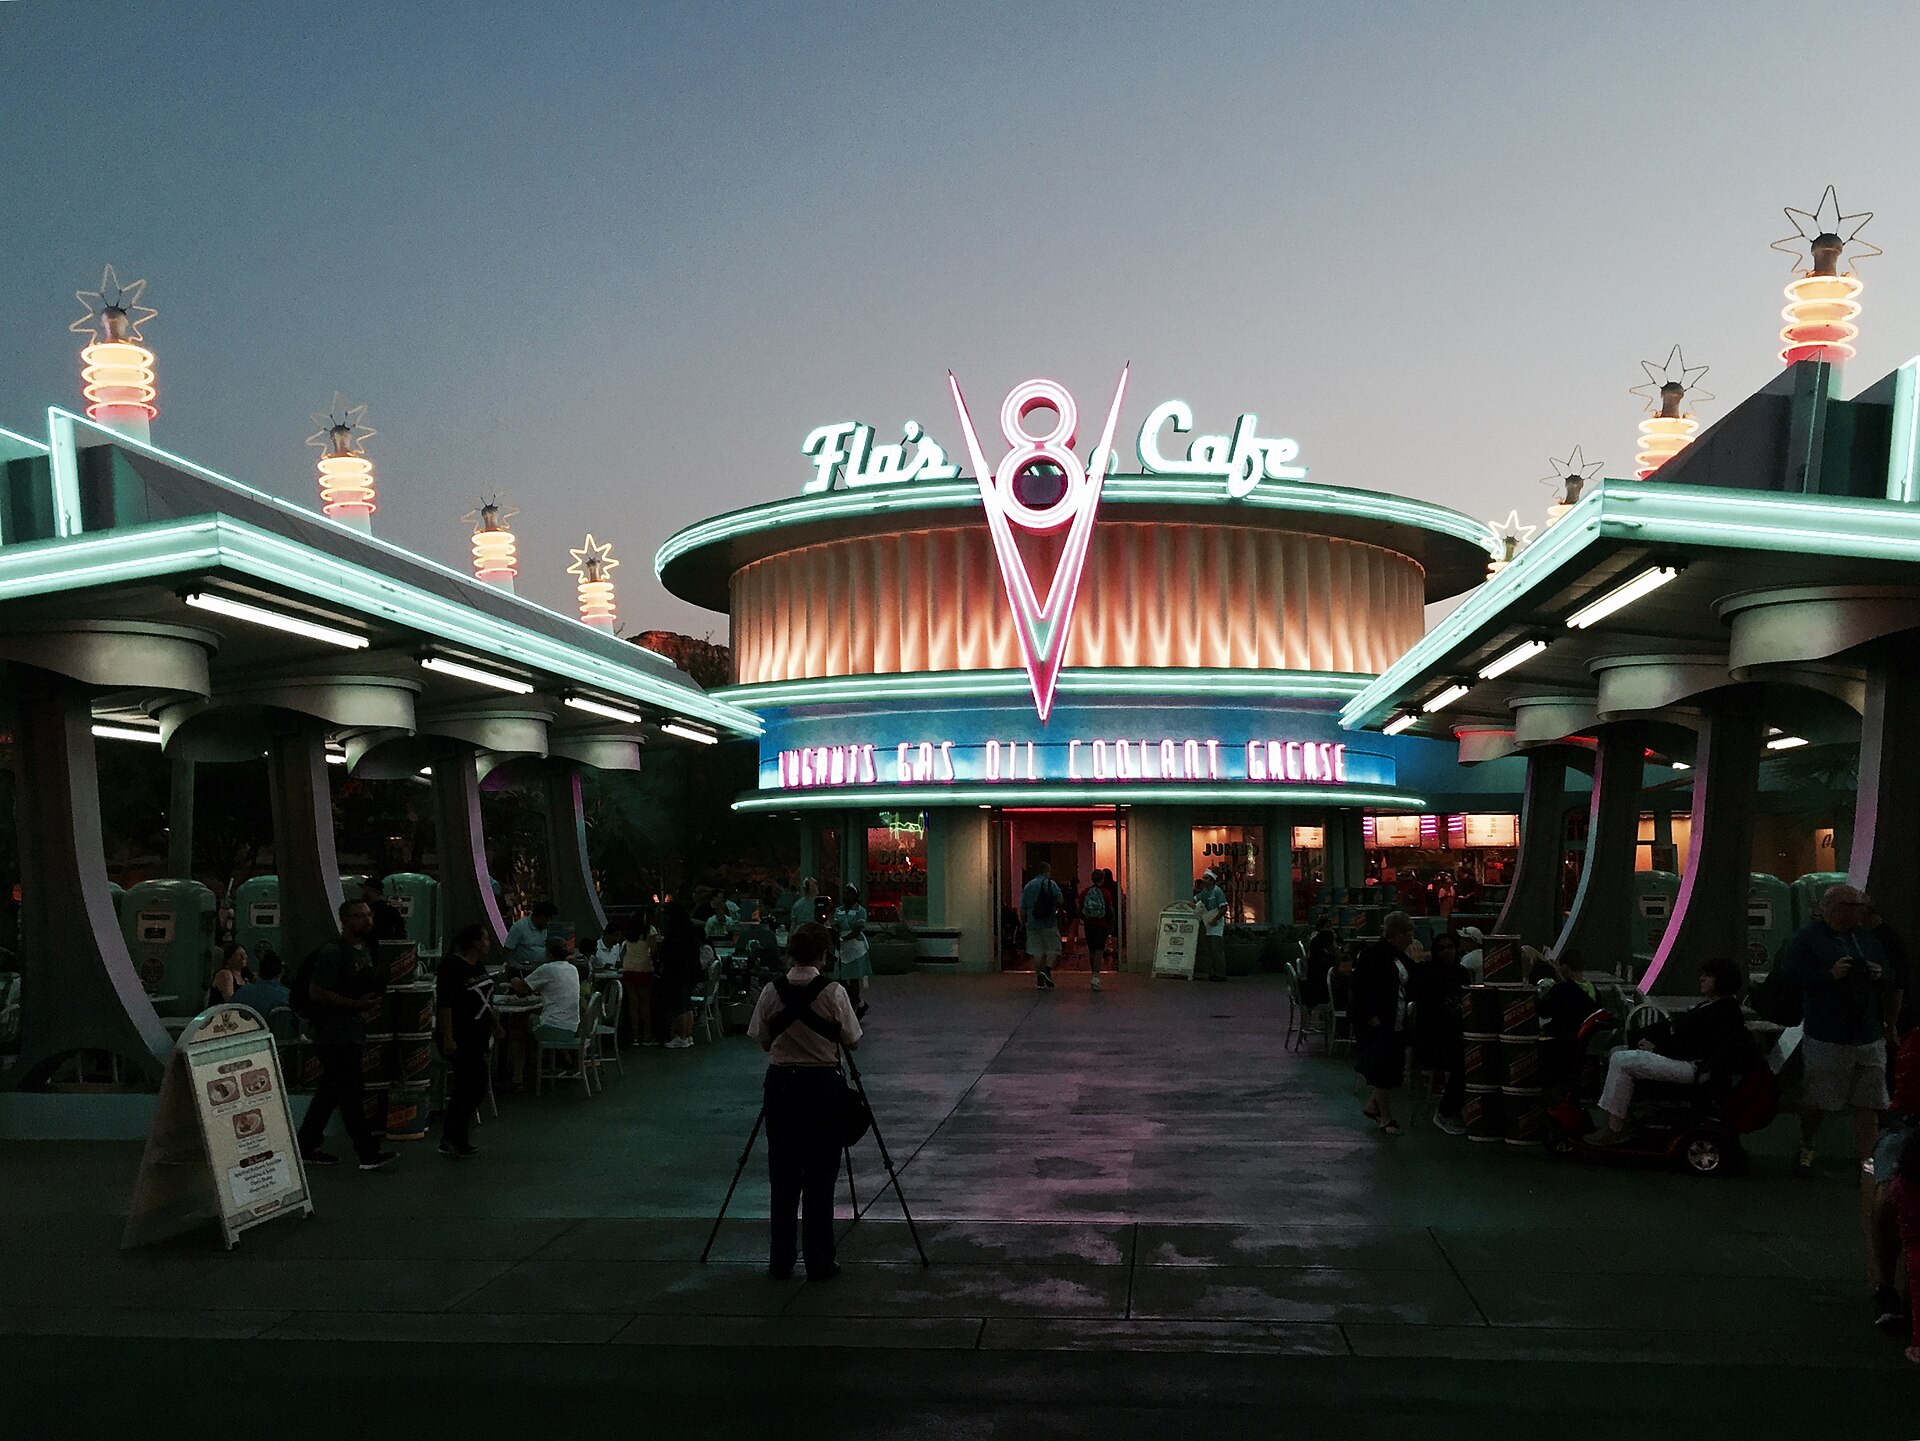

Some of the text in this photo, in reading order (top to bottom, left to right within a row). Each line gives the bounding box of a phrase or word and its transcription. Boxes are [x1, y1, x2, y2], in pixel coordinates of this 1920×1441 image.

[1136, 399, 1310, 499] Cafe
[897, 741, 955, 784] GAS
[984, 739, 1038, 783] OIL
[1068, 739, 1219, 781] COOLANT
[1246, 740, 1348, 784] GREASE
